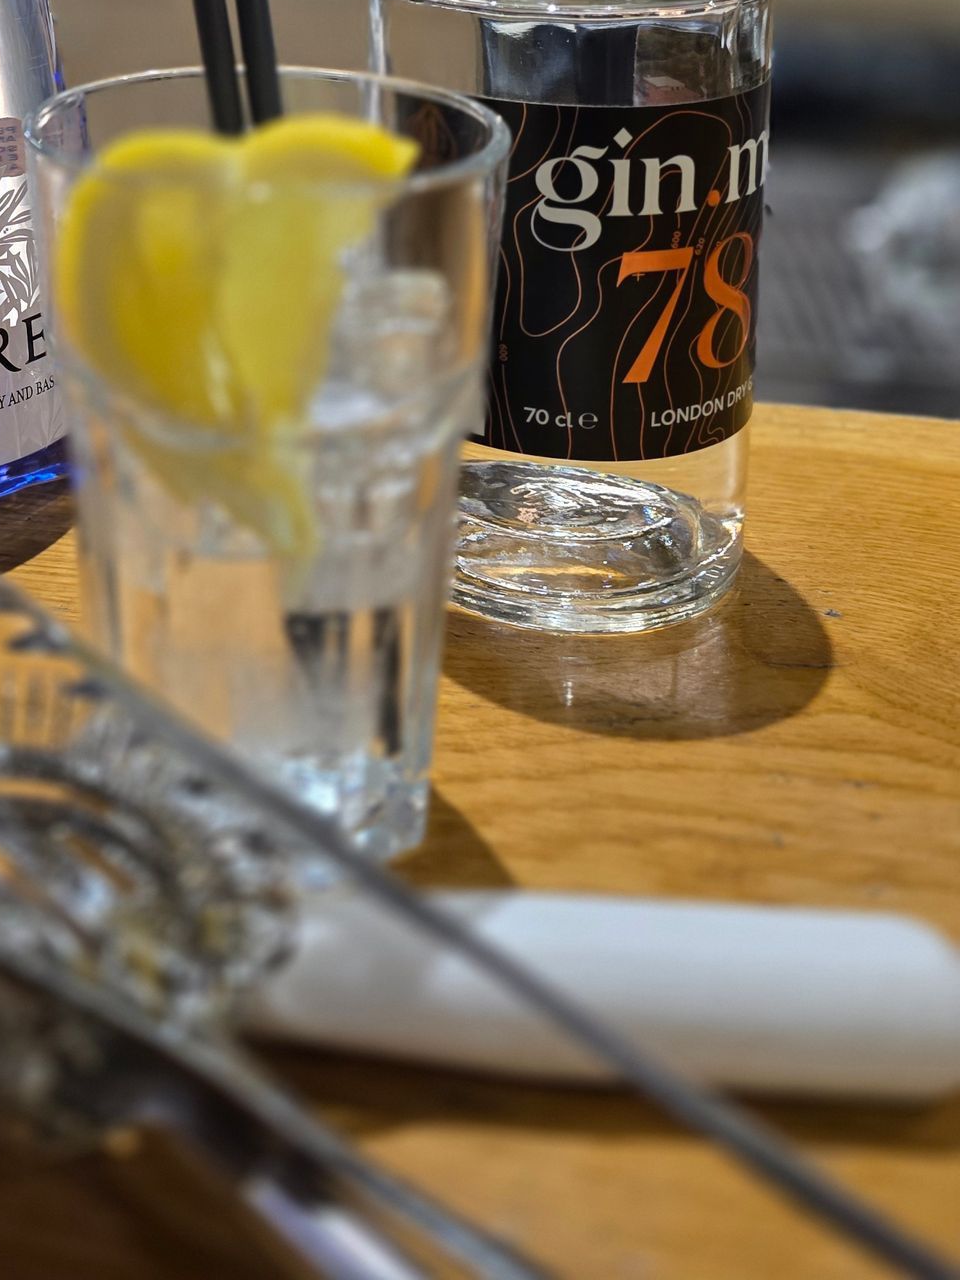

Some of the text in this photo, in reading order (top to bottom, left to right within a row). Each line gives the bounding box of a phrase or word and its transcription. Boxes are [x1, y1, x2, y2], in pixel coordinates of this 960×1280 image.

[616, 231, 753, 384] 78
[8, 385, 34, 407] AND
[36, 375, 55, 396] BAS
[651, 395, 724, 427] LONDON
[727, 381, 748, 409] DRY
[523, 406, 550, 425] 70
[555, 411, 574, 428] cl
